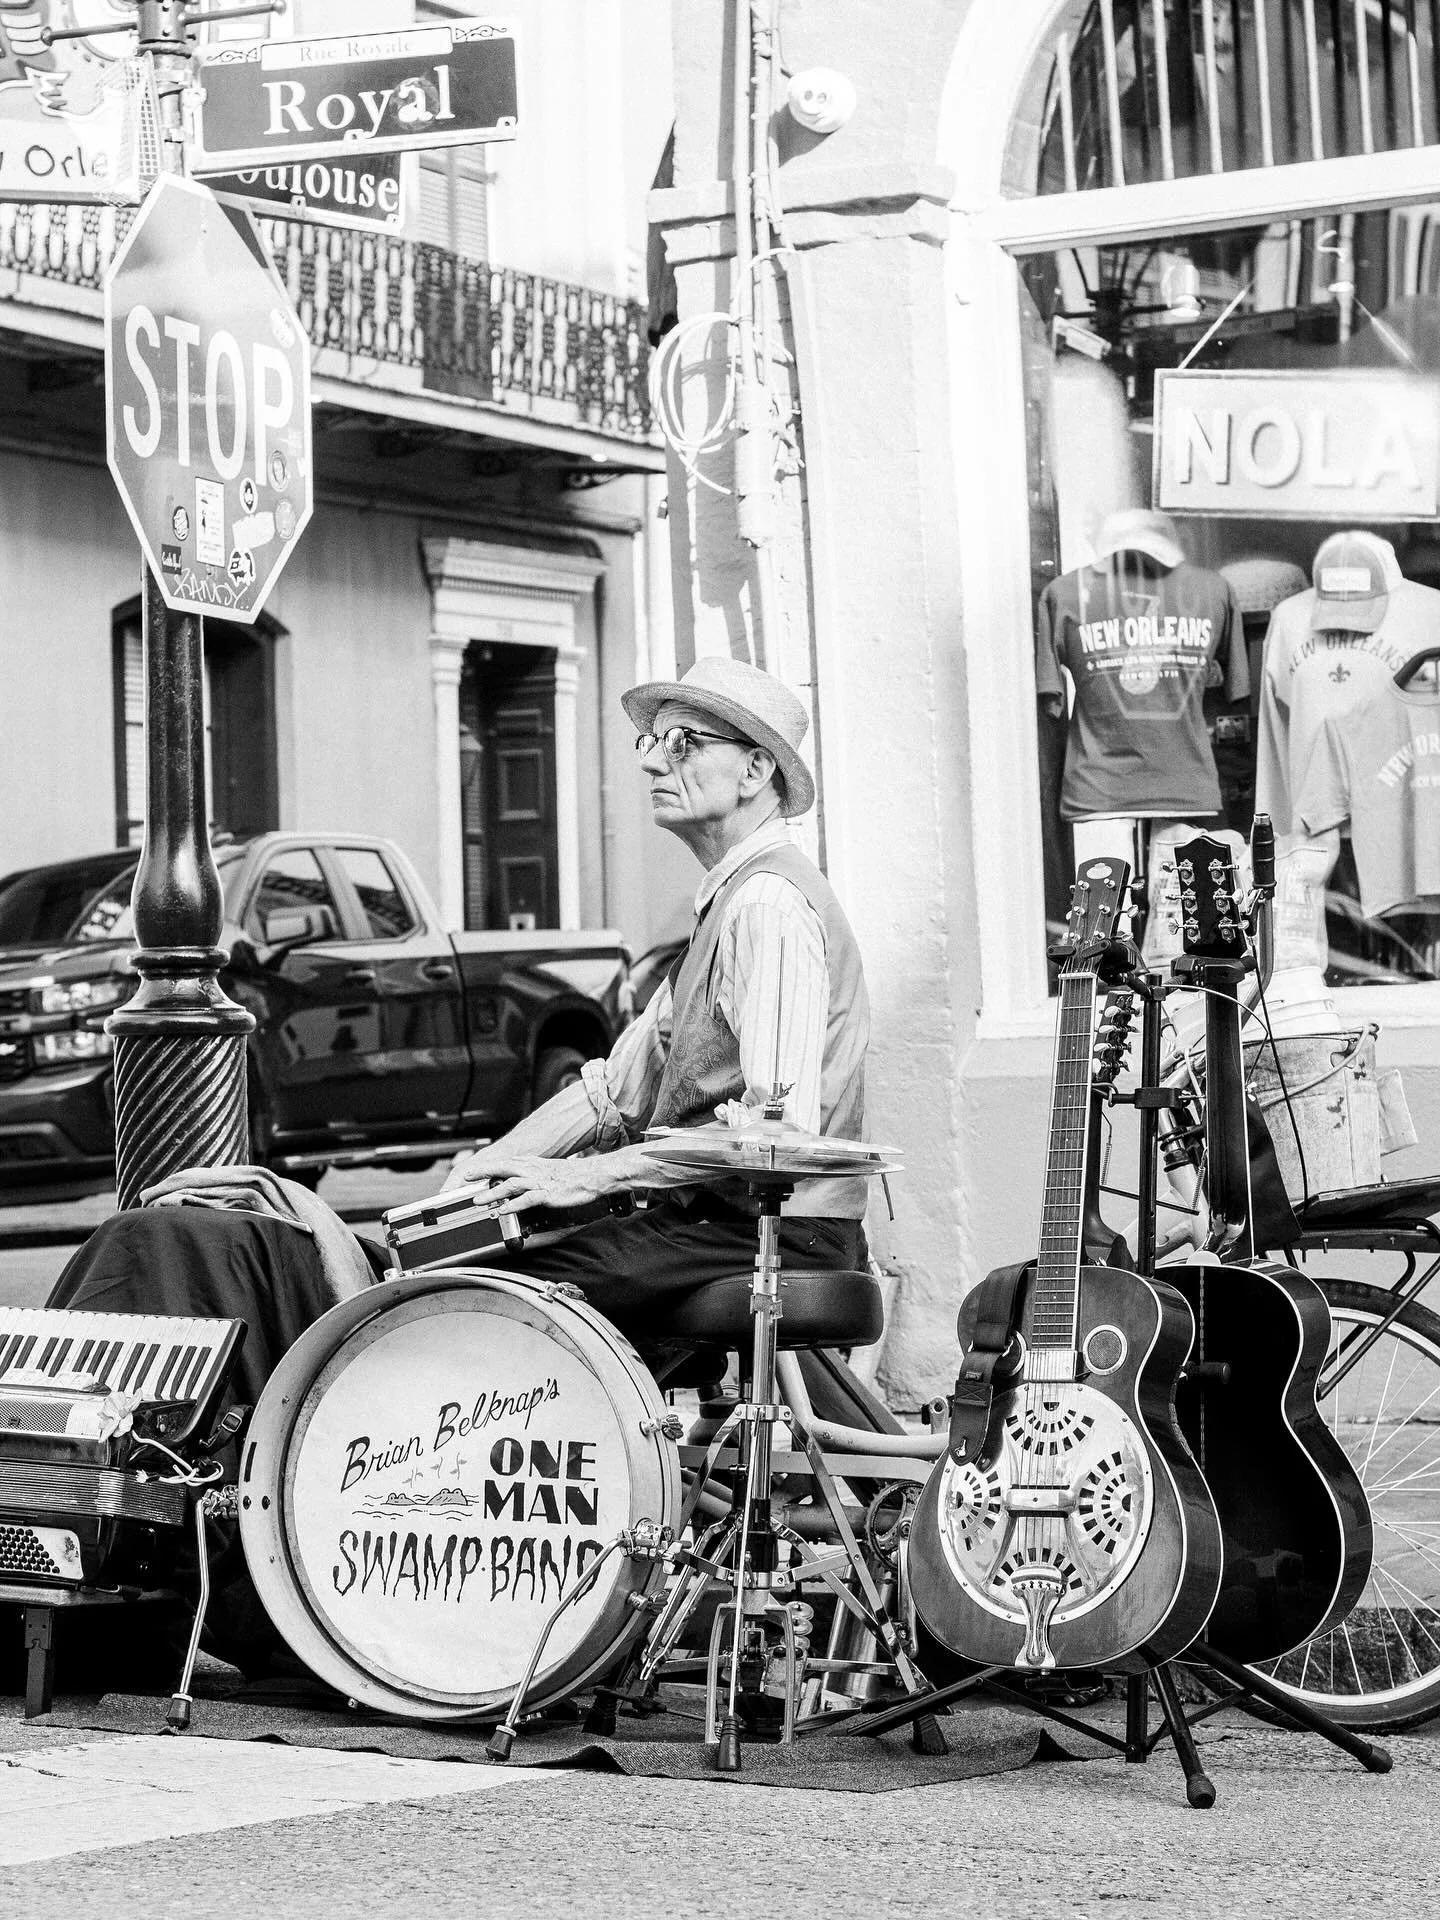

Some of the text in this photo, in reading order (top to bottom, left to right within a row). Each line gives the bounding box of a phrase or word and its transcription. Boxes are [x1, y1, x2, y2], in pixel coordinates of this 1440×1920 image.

[299, 37, 413, 61] Rue Royale
[262, 65, 457, 139] Royal
[24, 144, 109, 178] Orle
[236, 164, 400, 212] ulouse
[123, 304, 293, 487] STOP
[1173, 406, 1423, 491] NOLA
[1079, 616, 1212, 653] NEW ORLEANS
[340, 1377, 560, 1494] Brian Belknap's
[489, 1437, 597, 1482] ONE
[483, 1479, 599, 1526] MAN
